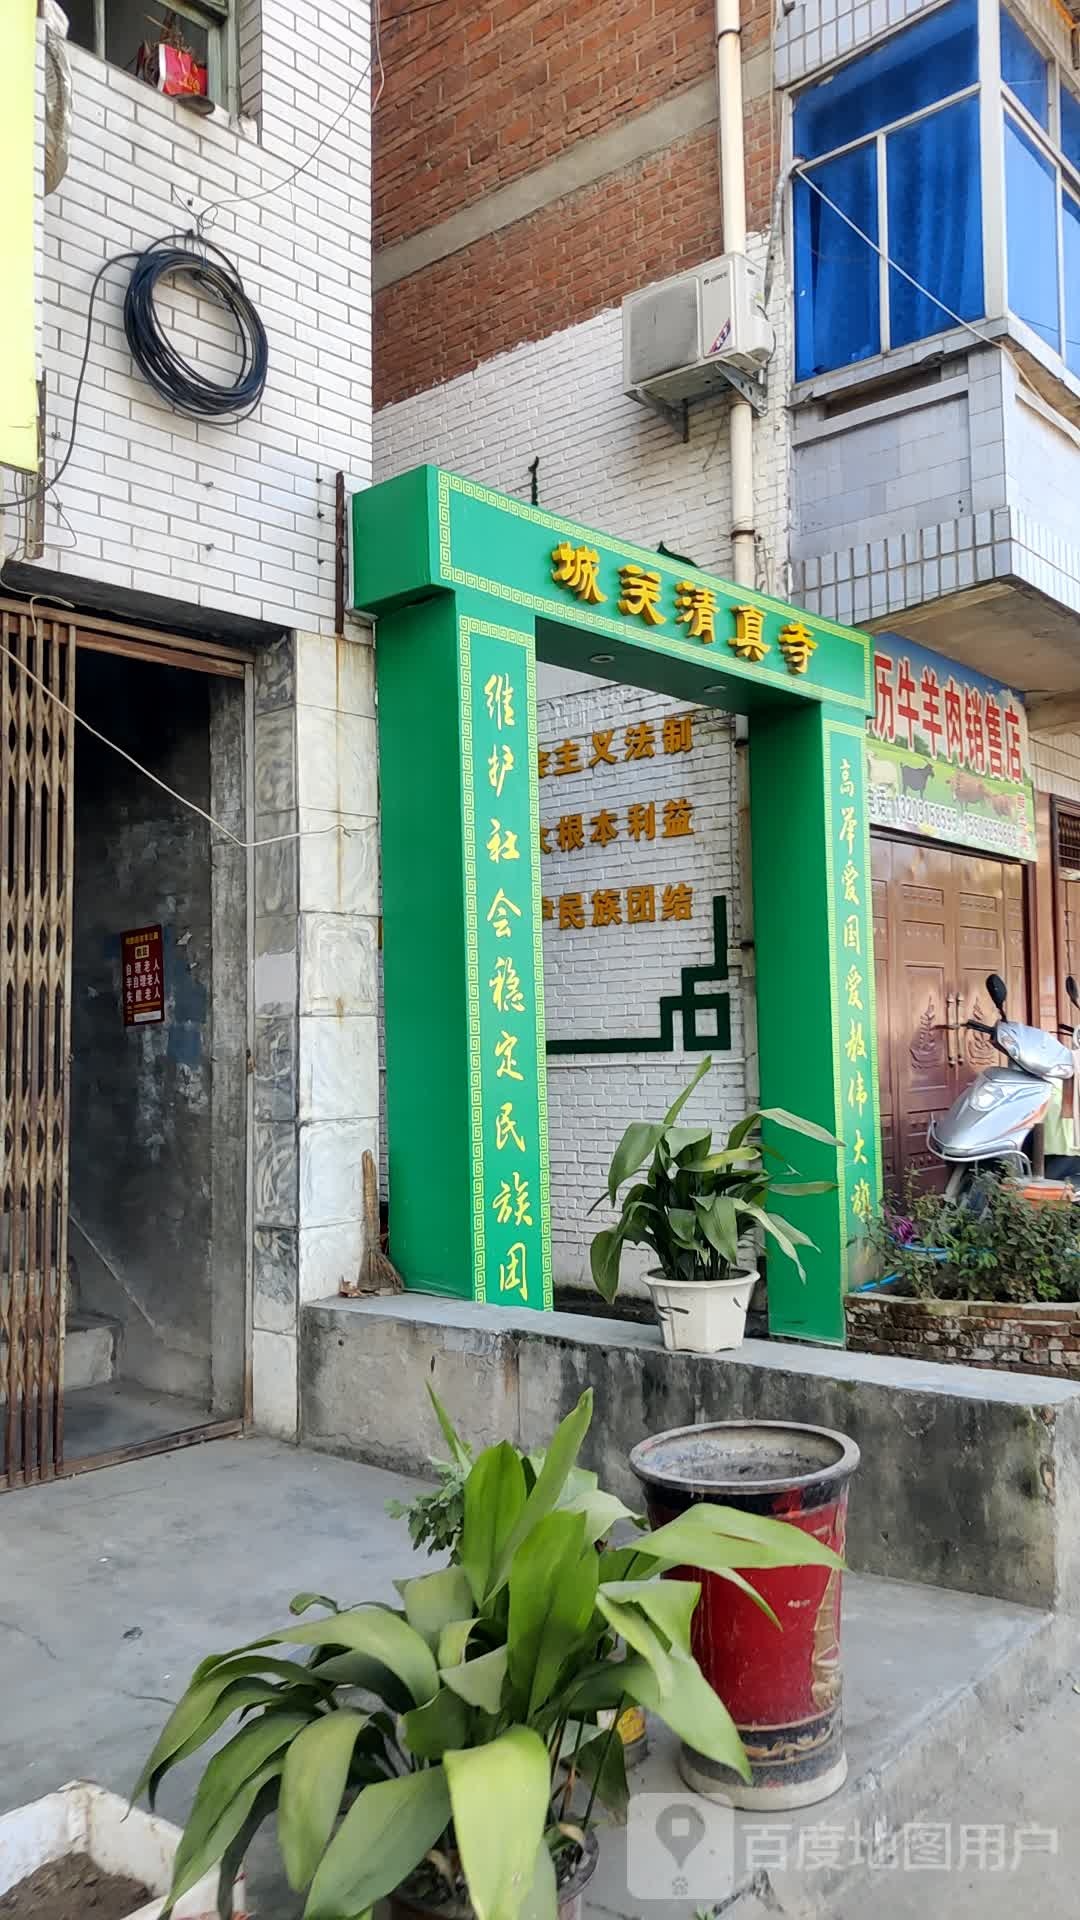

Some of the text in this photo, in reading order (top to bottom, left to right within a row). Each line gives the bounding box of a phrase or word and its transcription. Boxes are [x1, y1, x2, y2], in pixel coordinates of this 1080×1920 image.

[550, 540, 818, 675] 城关清真寺
[484, 672, 533, 1302] 维护社会稳定民族团
